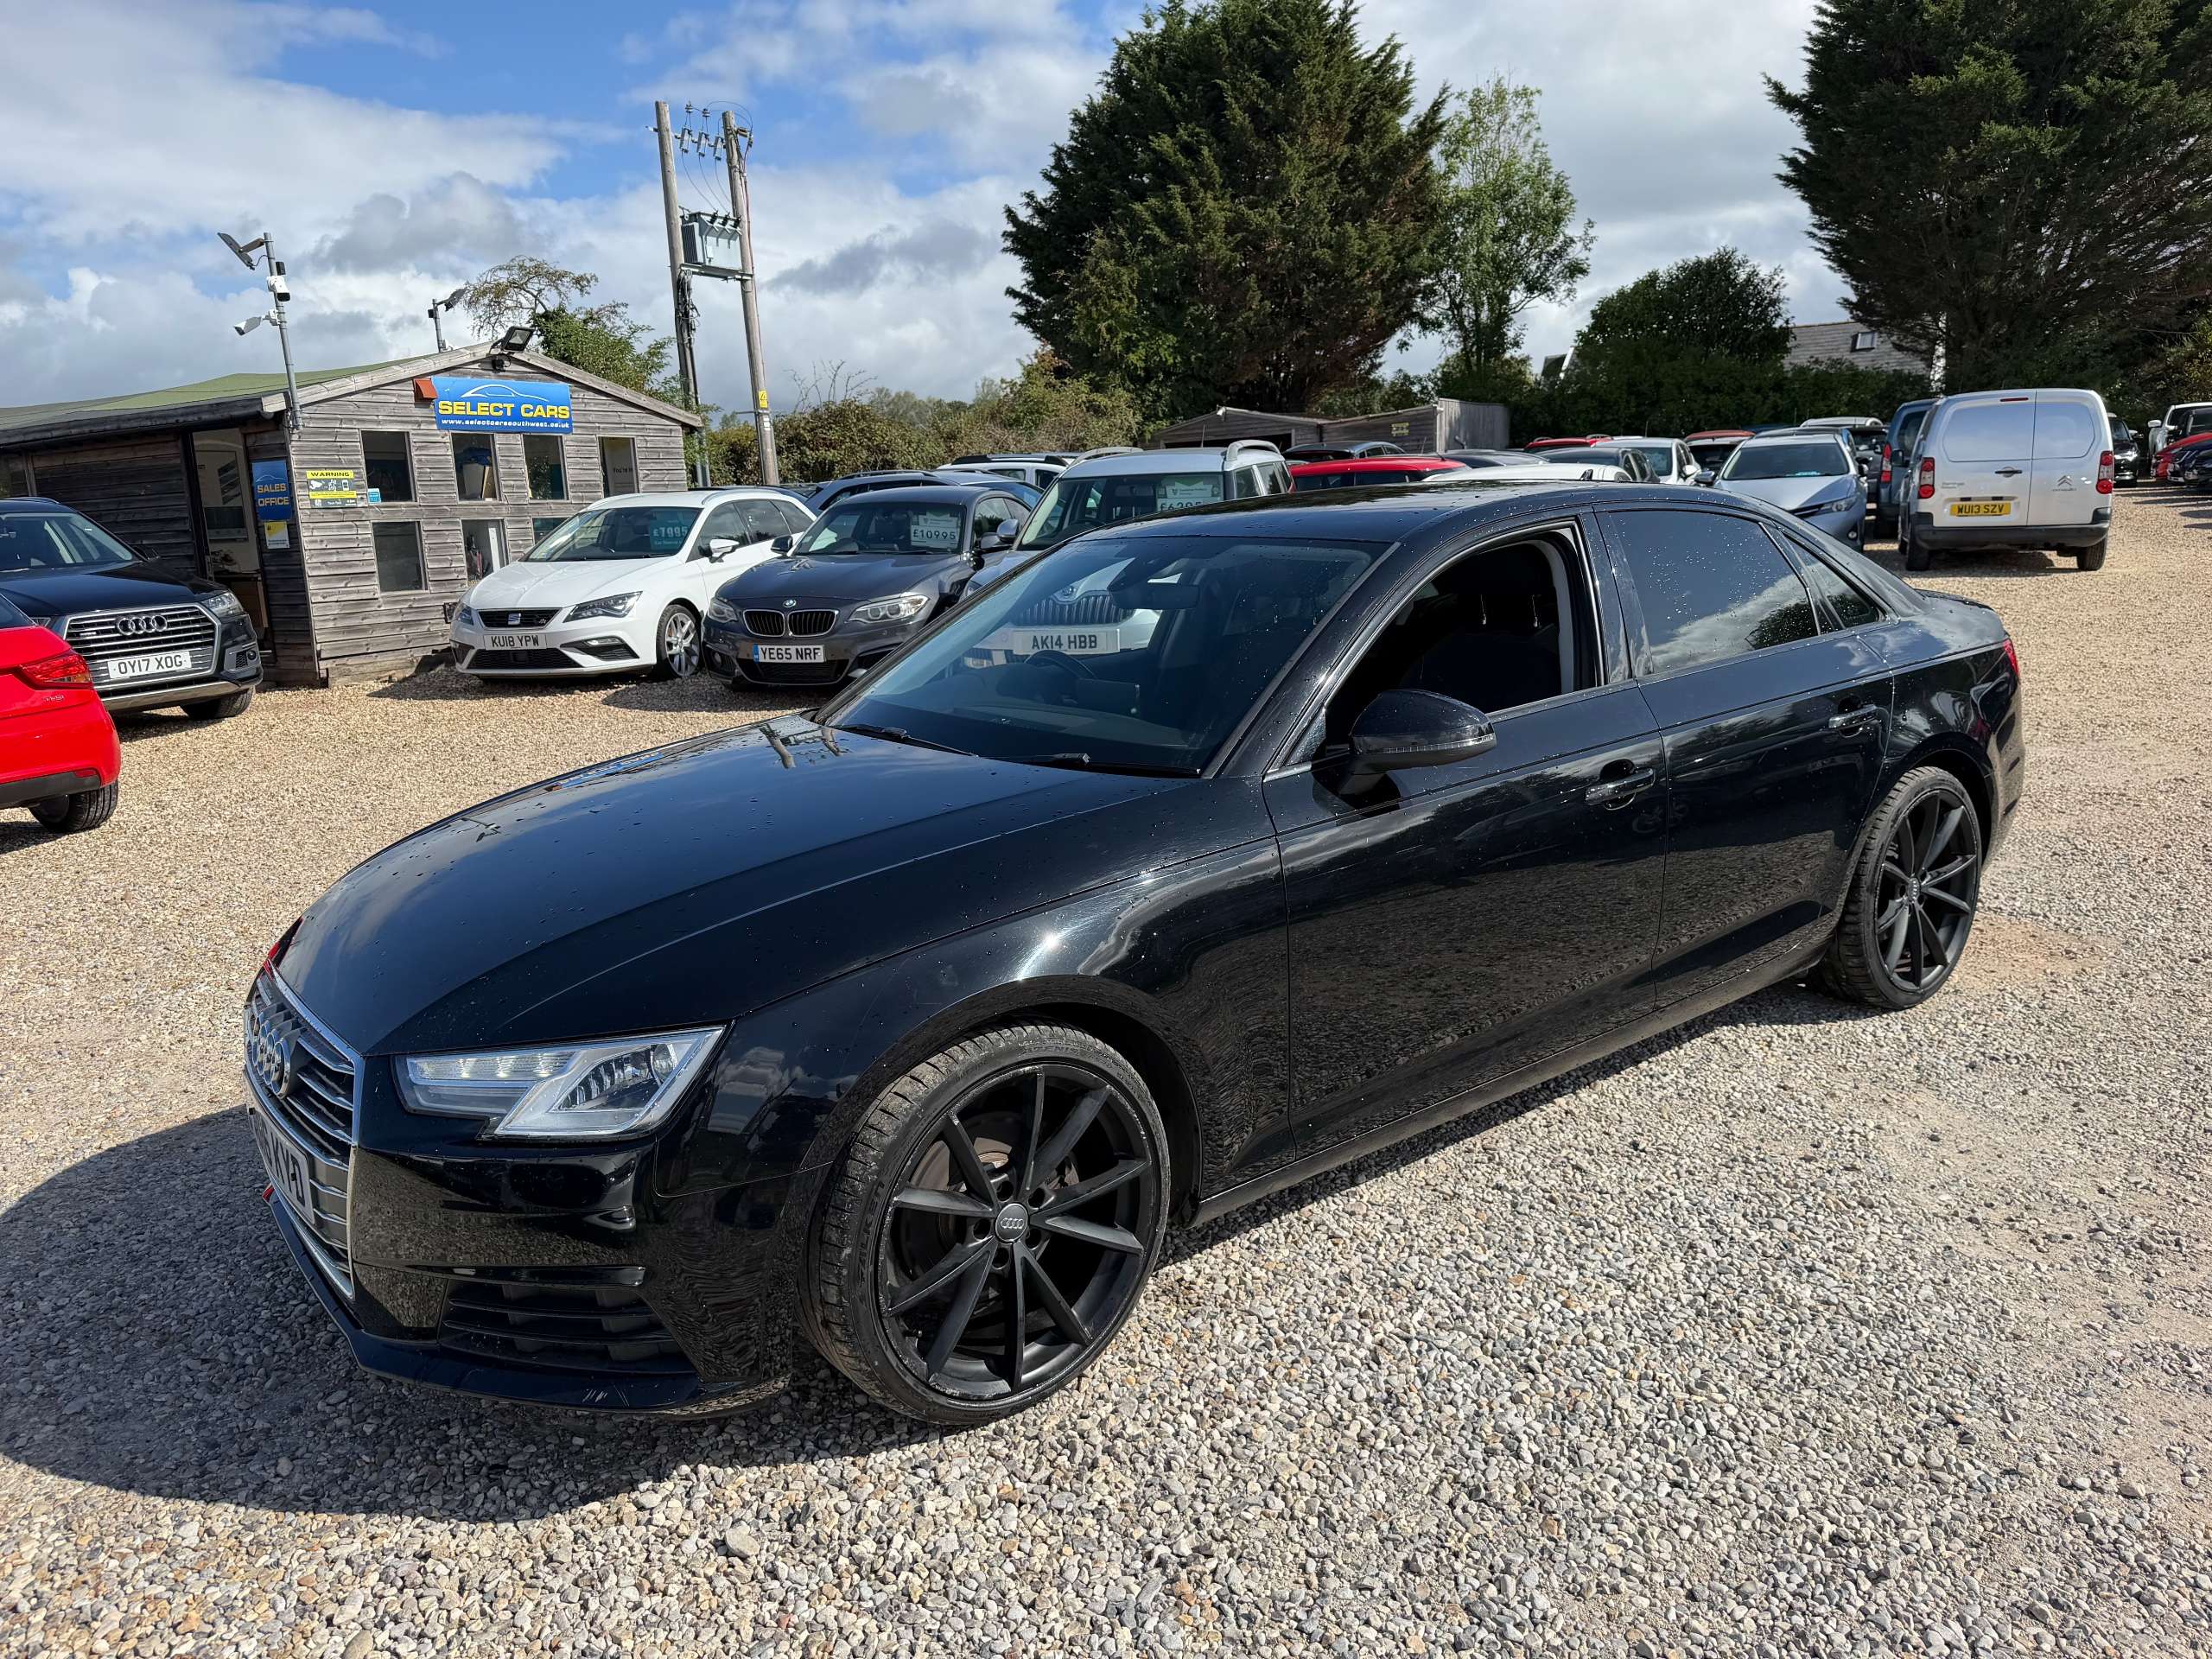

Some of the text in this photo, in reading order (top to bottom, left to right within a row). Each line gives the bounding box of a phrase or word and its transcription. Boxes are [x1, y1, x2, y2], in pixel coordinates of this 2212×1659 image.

[438, 401, 570, 419] SELECT CARS
[257, 483, 287, 493] SALES
[257, 496, 289, 506] OFFICE
[1957, 504, 2005, 514] WU13 SZV
[913, 529, 956, 540] £10995
[491, 635, 539, 647] KU18 YPW
[1032, 634, 1097, 650] AK14 HBB
[760, 648, 821, 660] YE65 NRF
[118, 654, 183, 675] OY17 XOG
